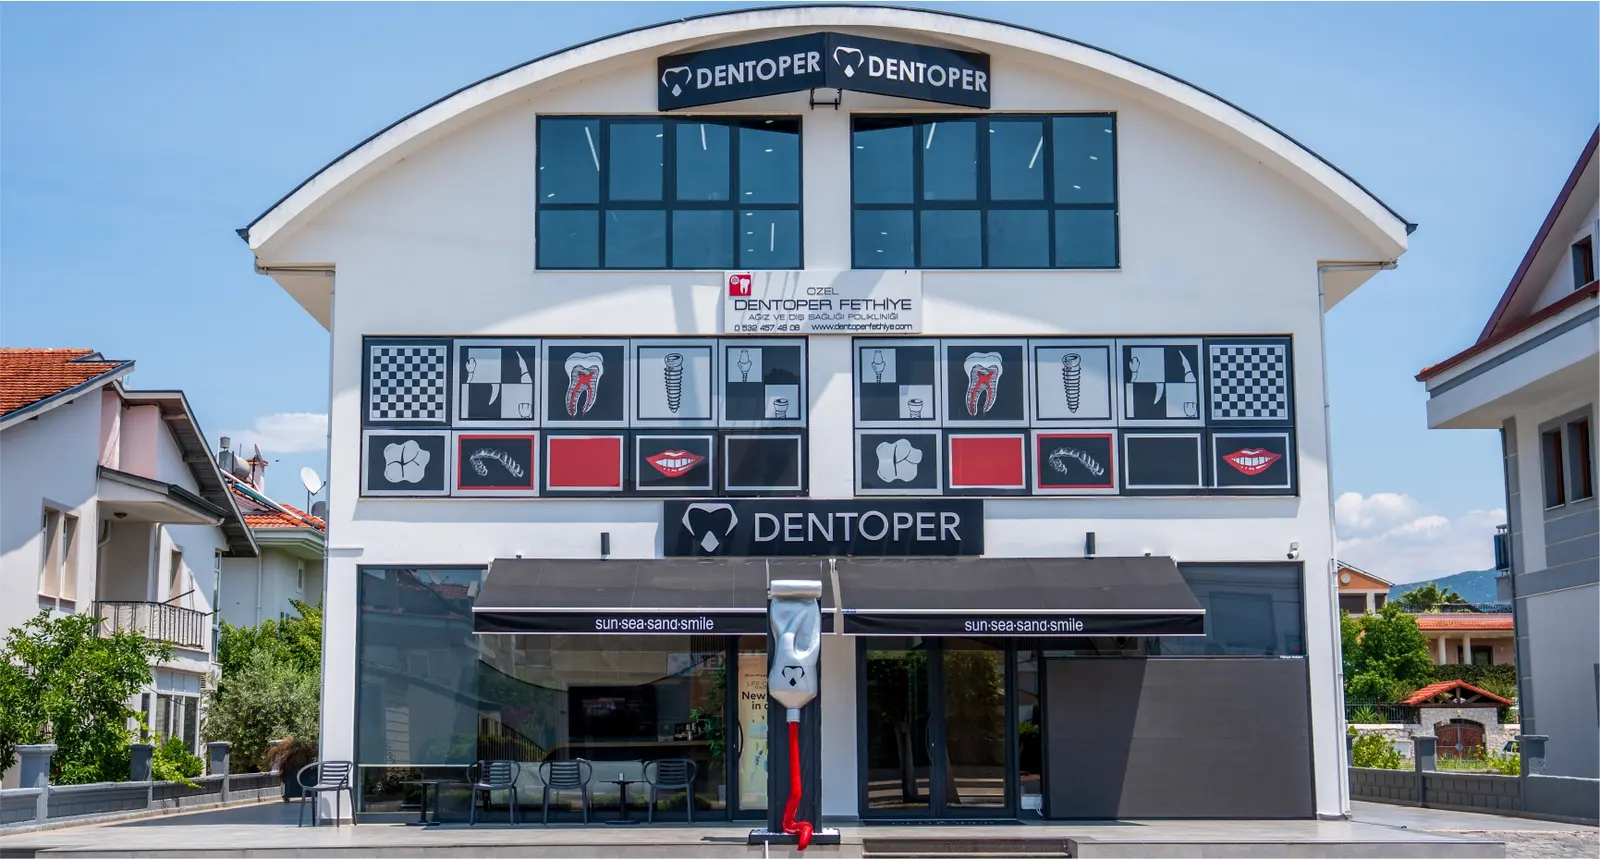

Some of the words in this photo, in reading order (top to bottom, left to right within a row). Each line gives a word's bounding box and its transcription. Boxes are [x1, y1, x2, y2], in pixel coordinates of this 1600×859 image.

[697, 51, 821, 90] DENTOPER
[868, 55, 988, 93] DENTOPER
[734, 299, 833, 311] DENTOPER
[773, 313, 786, 321] VE
[734, 324, 740, 332] 0
[741, 324, 758, 332] 532
[760, 324, 776, 332] 457
[754, 510, 962, 542] DENTOPER
[741, 691, 766, 700] New
[751, 700, 762, 710] in
